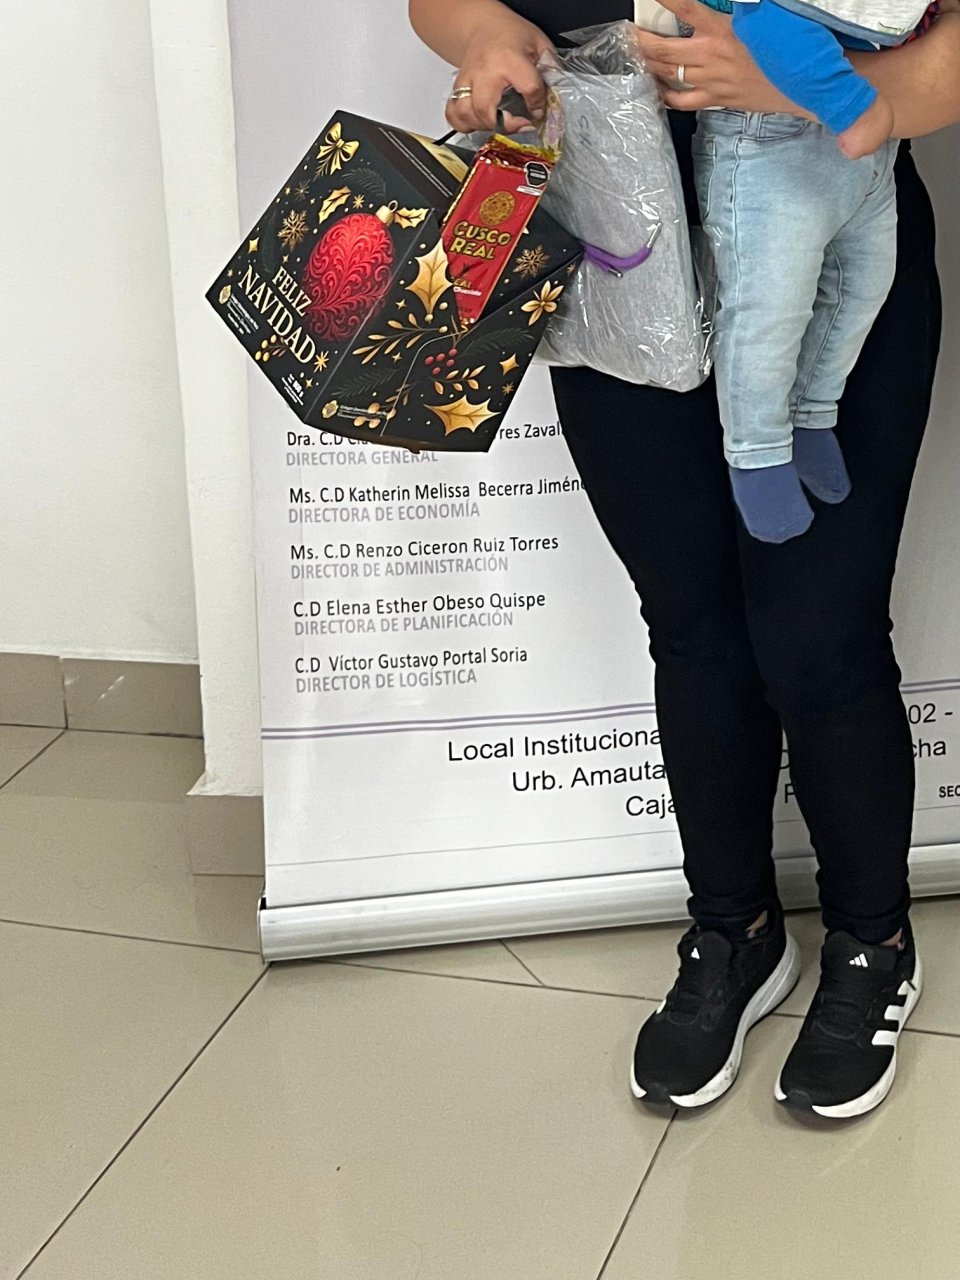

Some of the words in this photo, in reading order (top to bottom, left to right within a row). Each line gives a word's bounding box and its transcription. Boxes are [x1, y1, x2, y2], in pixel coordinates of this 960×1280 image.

[454, 221, 512, 246] CUSCO
[450, 237, 496, 260] REAL
[272, 266, 313, 317] FELIZ
[238, 264, 316, 363] NAVIDAD
[287, 432, 315, 446] Dra.
[524, 422, 565, 439] Zaval
[286, 451, 367, 466] DIRECTORA
[371, 450, 438, 465] GENERAL
[290, 487, 315, 503] Ms.
[320, 487, 344, 503] C.D
[349, 485, 410, 502] Katherin
[415, 483, 470, 500] Melissa
[479, 482, 533, 497] Becerra
[289, 507, 370, 523] DIRECTORA
[375, 506, 393, 521] DE
[398, 500, 480, 520] ECONOMÍA
[291, 545, 318, 560] Ms.
[324, 544, 350, 559] C.D
[356, 543, 403, 558] Renzo
[408, 541, 468, 556] Ciceron
[473, 538, 505, 552] Ruiz
[510, 536, 559, 551] Torres
[291, 563, 359, 579] DIRECTOR
[363, 563, 381, 577] DE
[385, 554, 508, 576] ADMINISTRACIÓN
[294, 601, 320, 617] C.D
[327, 599, 370, 615] Elena
[377, 597, 428, 614] Esther
[433, 595, 484, 611] Obeso
[490, 592, 545, 611] Quispe
[294, 618, 376, 635] DIRECTORA
[381, 618, 399, 632] DE
[403, 610, 513, 631] PLANIFICACIÓN
[295, 657, 320, 673] C.D
[329, 654, 373, 671] Víctor
[379, 654, 438, 669] Gustavo
[443, 647, 486, 666] Portal
[491, 647, 527, 663] Soria
[296, 674, 370, 693] DIRECTOR
[375, 673, 394, 688] DE
[399, 667, 477, 687] LOGÍSTICA
[448, 737, 514, 762] Local
[513, 770, 563, 791] Urb.
